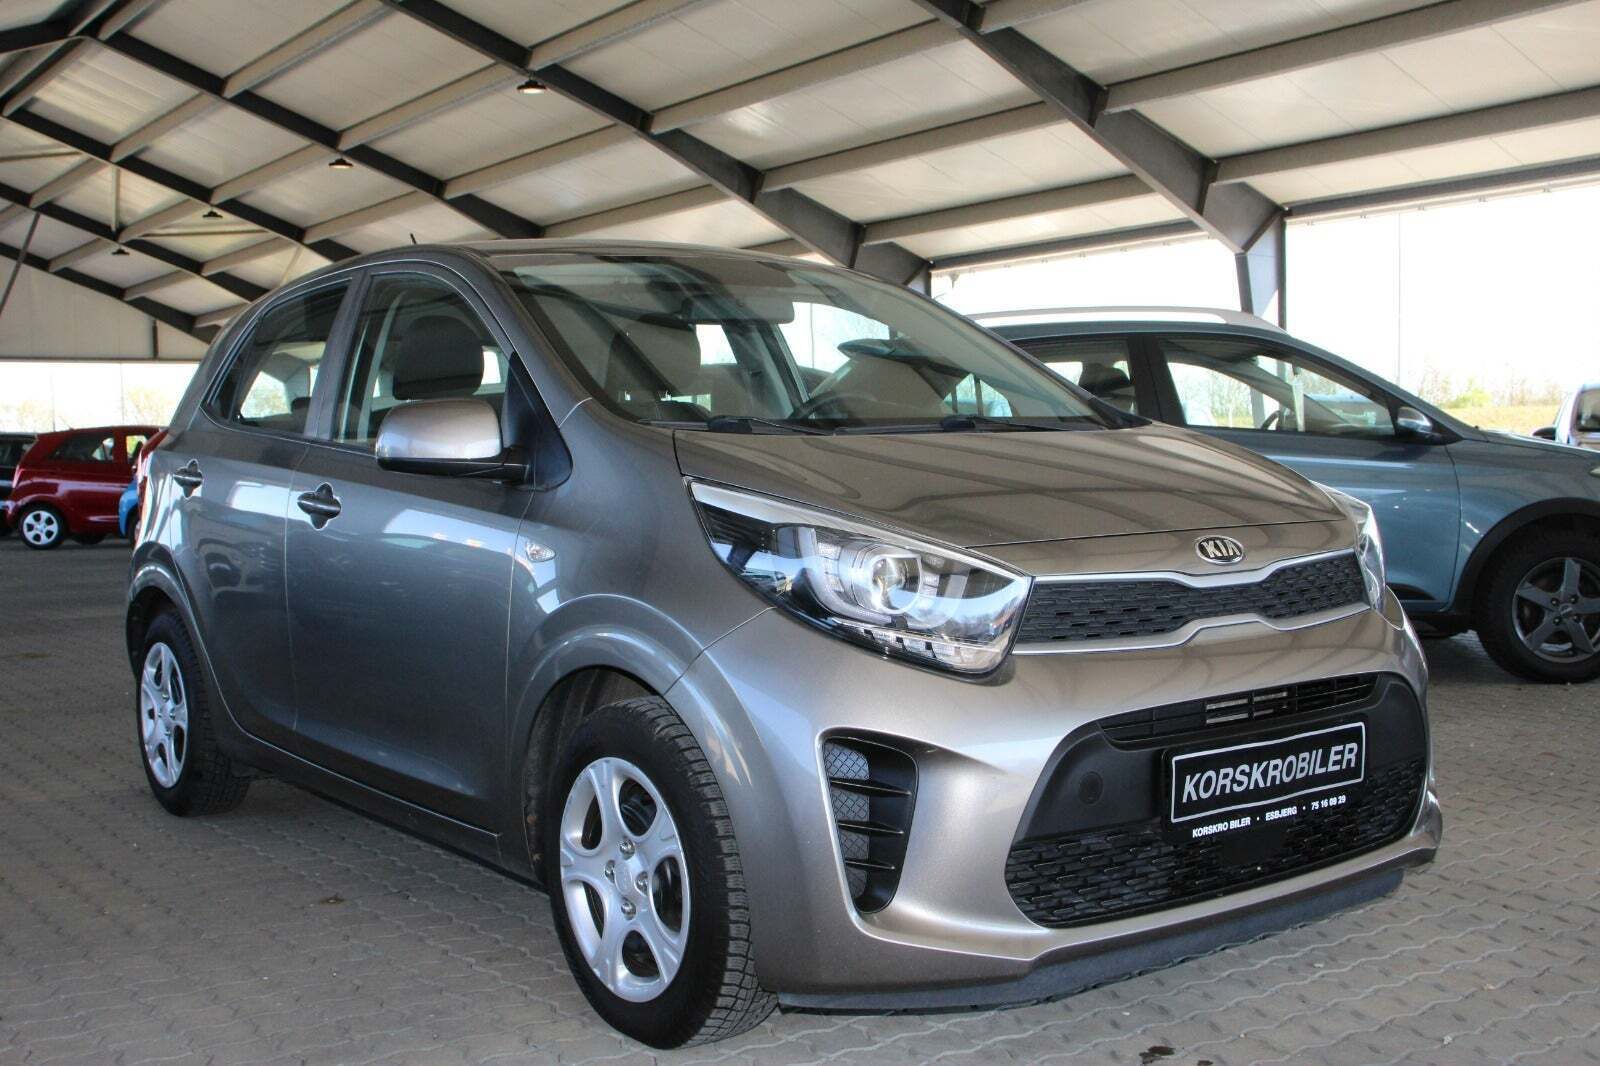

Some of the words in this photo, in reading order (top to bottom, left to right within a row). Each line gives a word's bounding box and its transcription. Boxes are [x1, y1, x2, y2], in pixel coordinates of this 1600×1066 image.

[1201, 540, 1241, 558] KIA
[1182, 742, 1358, 803] KORSKROBILER
[1192, 821, 1228, 838] KORSKRO
[1229, 816, 1251, 830] BILER
[1265, 805, 1297, 821] ESBJERG
[1311, 800, 1320, 811] 75
